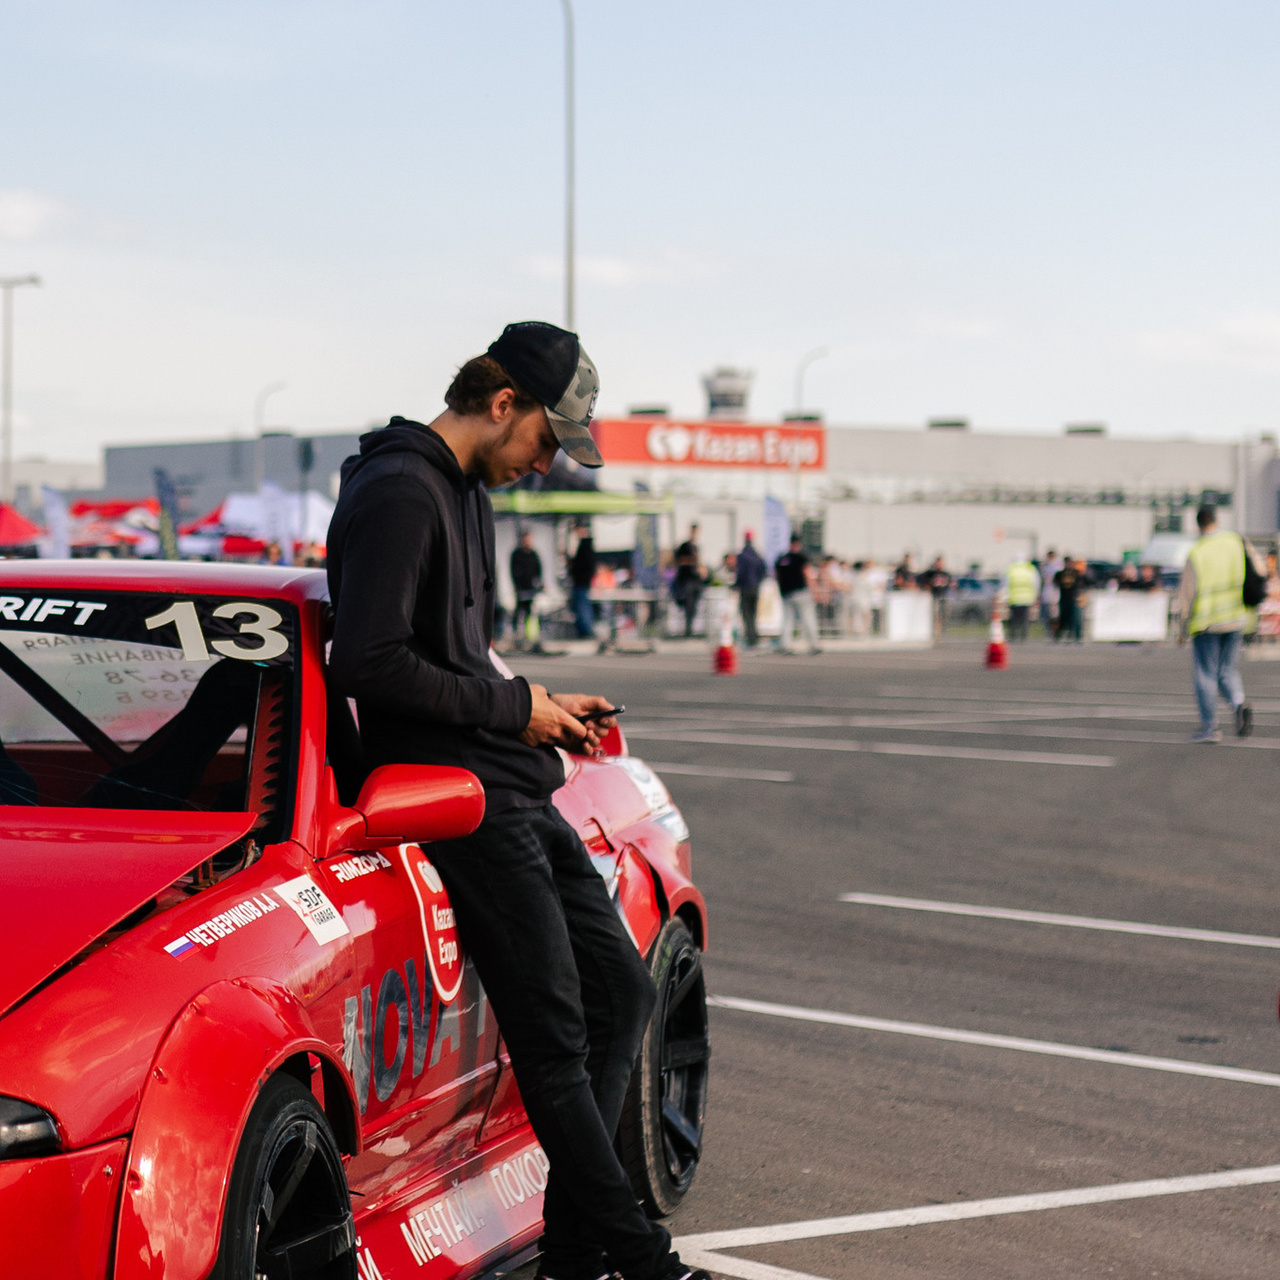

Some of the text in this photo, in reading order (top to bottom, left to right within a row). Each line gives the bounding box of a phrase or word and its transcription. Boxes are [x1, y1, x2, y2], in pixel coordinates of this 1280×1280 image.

[692, 428, 819, 468] Kazan Expo
[145, 601, 289, 662] 13
[298, 886, 324, 908] SDF
[186, 900, 263, 947] ЧЕТВЕРИКОВ
[438, 936, 458, 970] Expo
[399, 1177, 487, 1267] МЕЧТАЙ.
